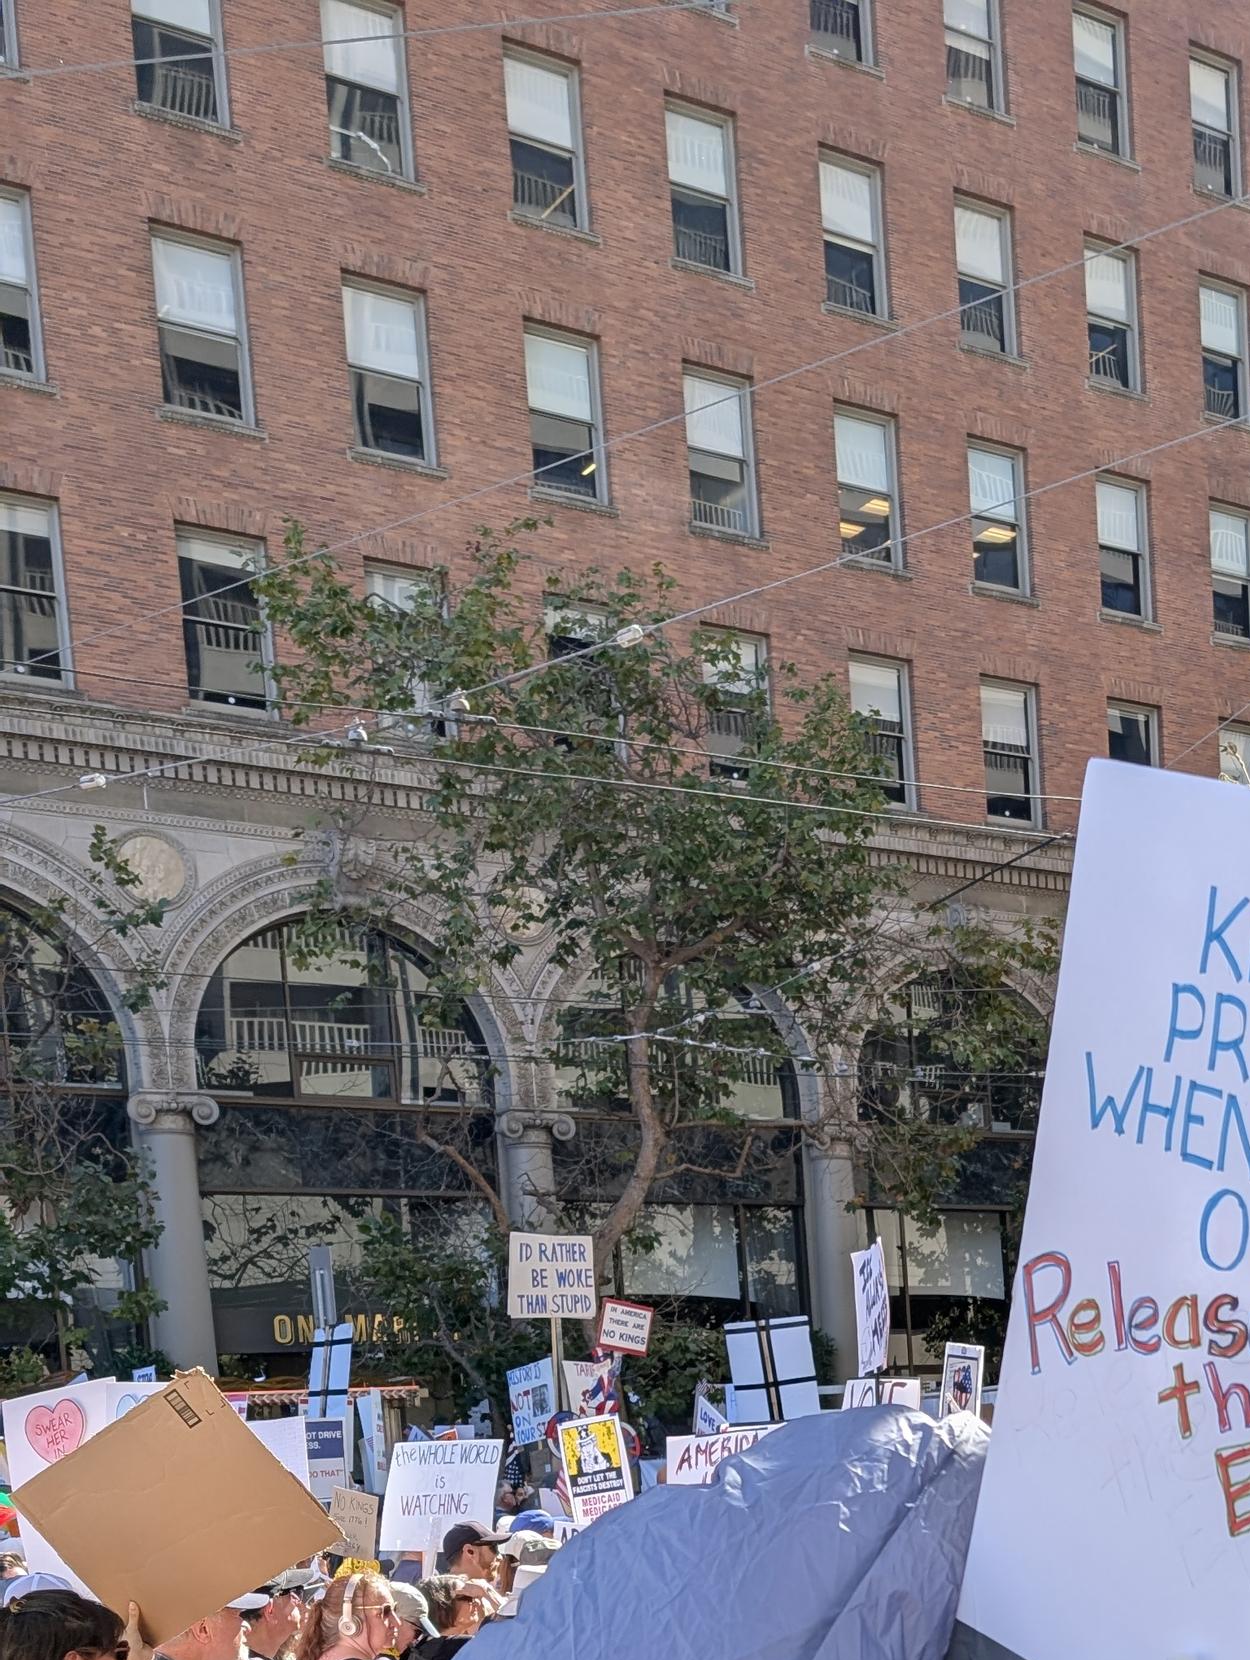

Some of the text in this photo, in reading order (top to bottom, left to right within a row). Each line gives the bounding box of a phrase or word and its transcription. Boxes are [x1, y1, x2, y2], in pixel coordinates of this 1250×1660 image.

[538, 1242, 587, 1263] RATHER
[531, 1268, 594, 1288] BE WOKE
[517, 1294, 592, 1314] THAN STUPID
[620, 1309, 647, 1320] AMERICA
[609, 1317, 645, 1331] THERE ARE
[602, 1328, 647, 1346] NO KINGS
[34, 1412, 73, 1437] SWEAR
[515, 1414, 532, 1429] ON
[700, 1407, 716, 1432] LOVE
[46, 1429, 70, 1449] HER
[318, 1430, 342, 1439] DRIVE
[516, 1427, 536, 1444] YOUR
[53, 1445, 67, 1460] IN
[395, 1445, 417, 1468] the
[418, 1443, 459, 1466] WHOLE
[460, 1443, 500, 1465] WORLD
[435, 1474, 446, 1489] is
[593, 1473, 605, 1482] LET
[605, 1471, 618, 1480] THE
[572, 1479, 624, 1495] FASCISTS DESTROY
[334, 1490, 375, 1515] NO KINGS
[400, 1492, 469, 1517] WATCHING
[581, 1492, 621, 1507] MEDICAID
